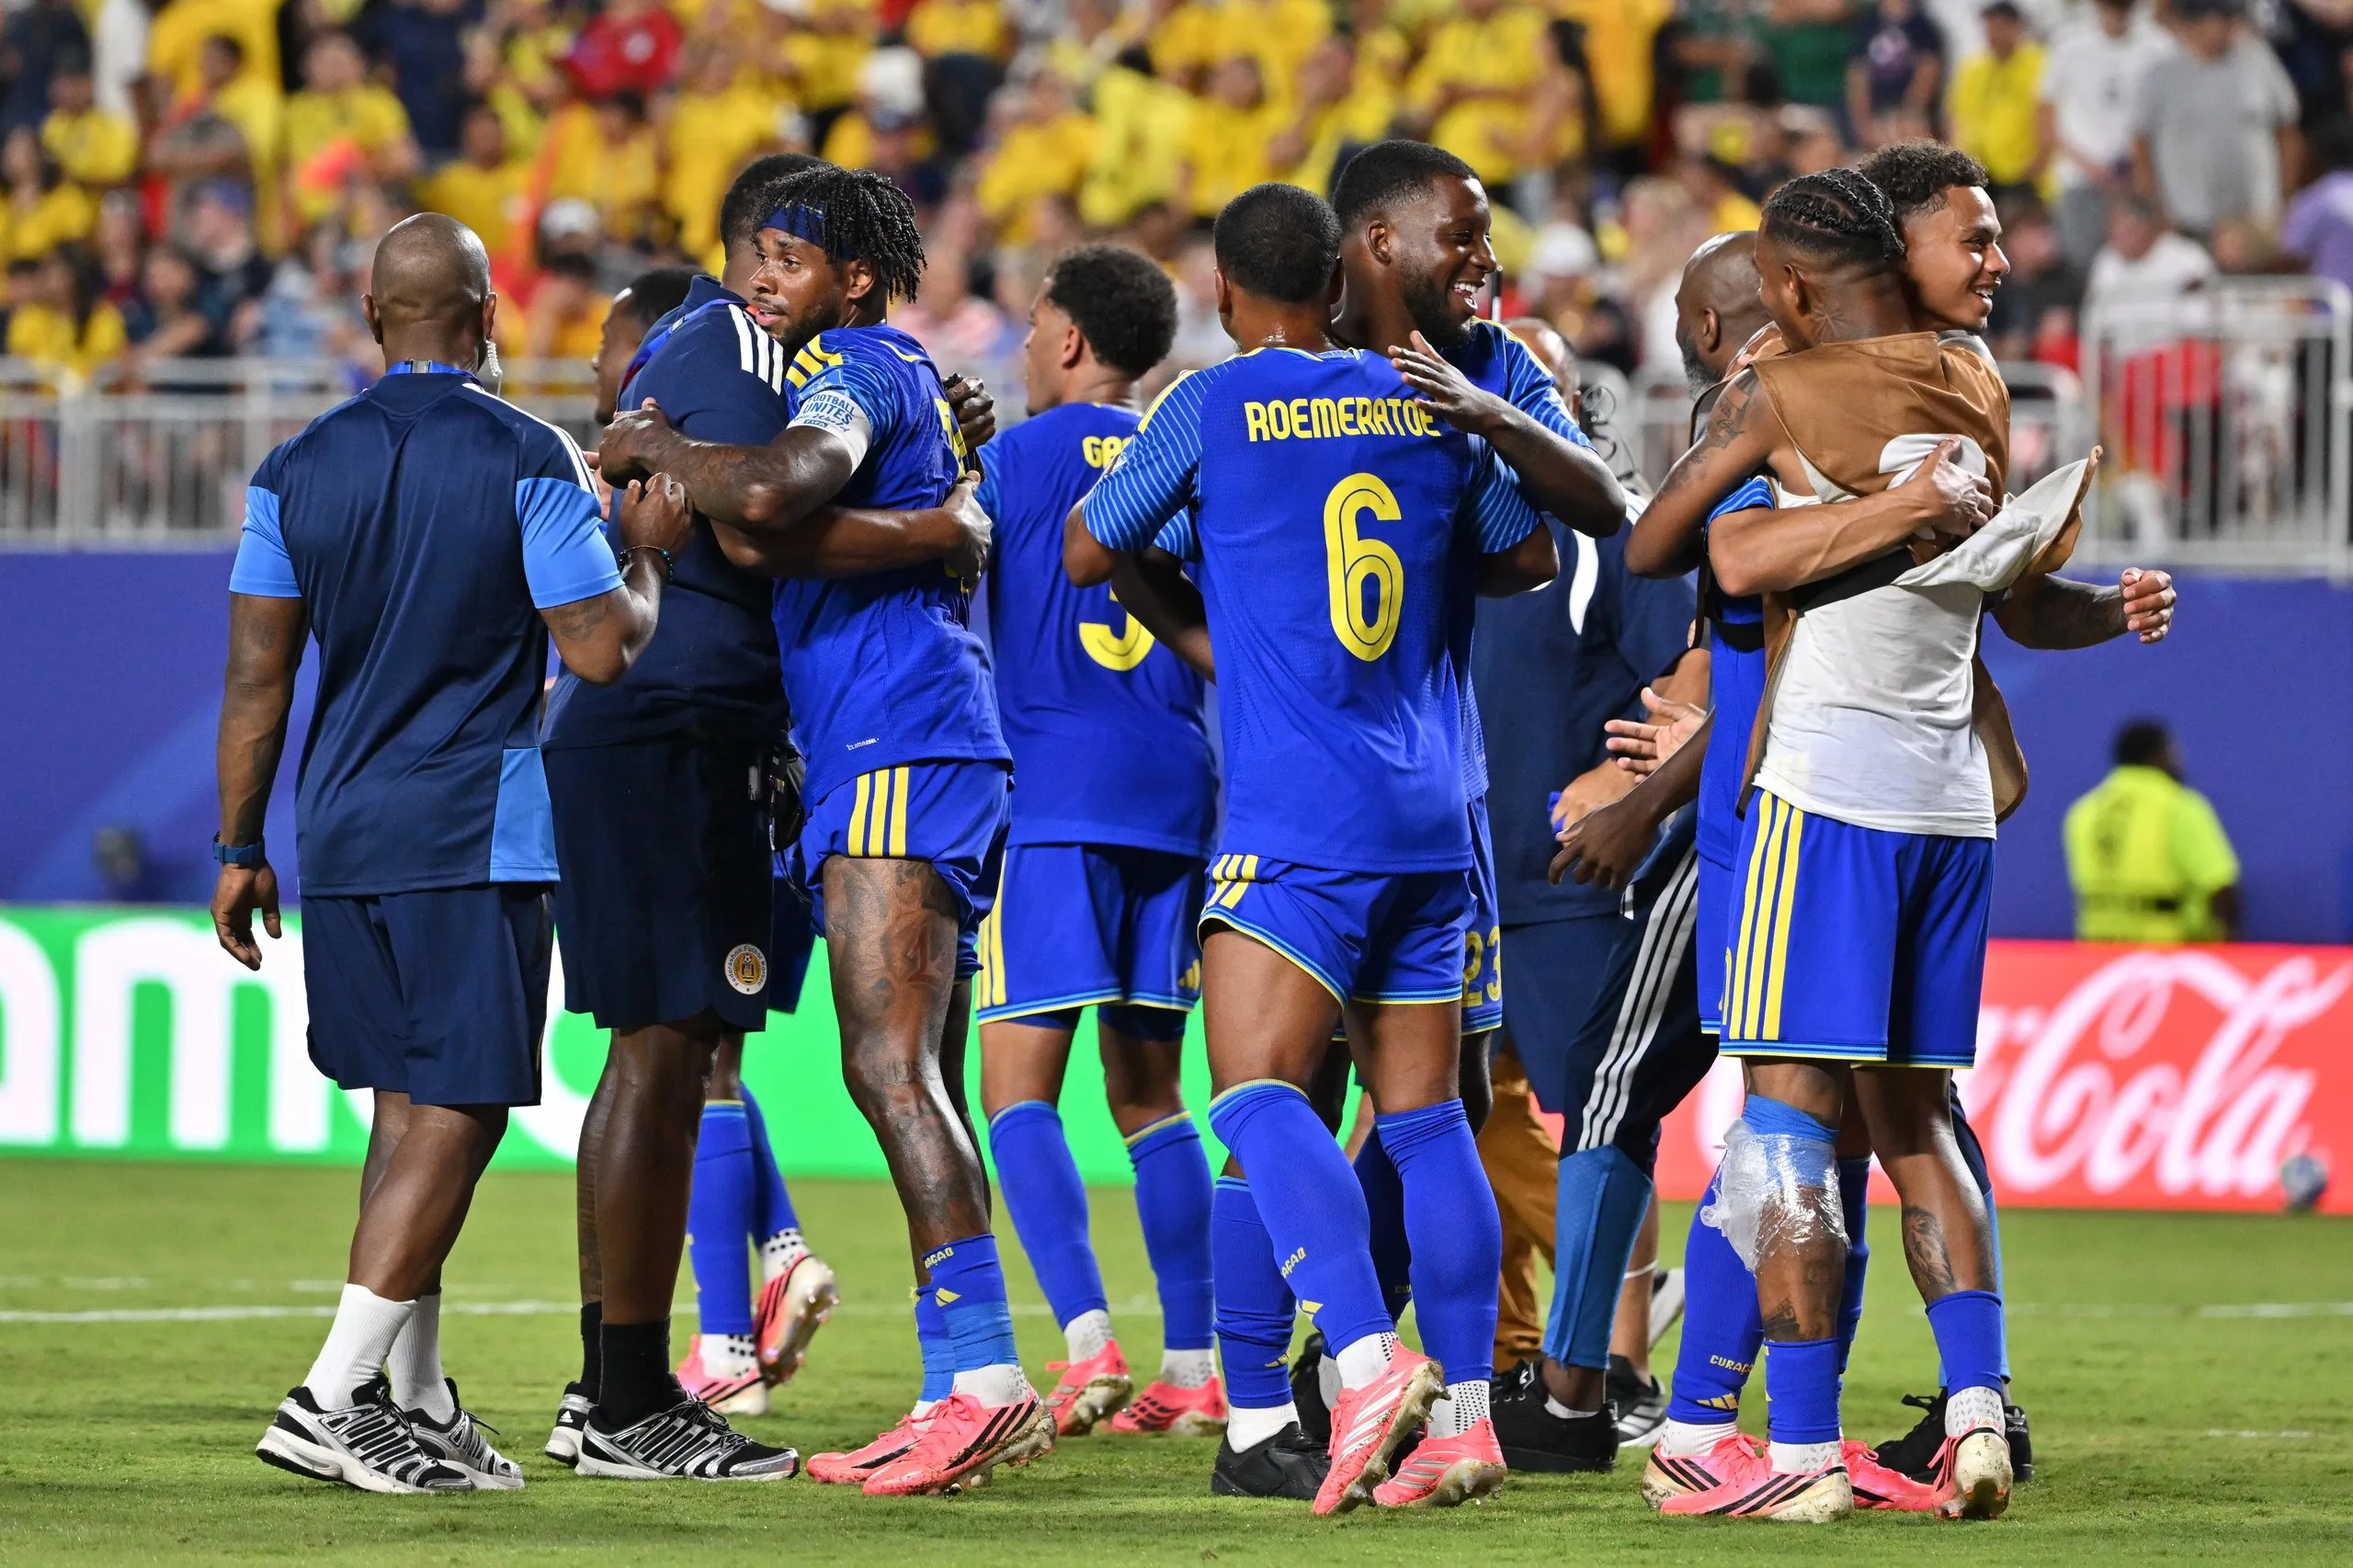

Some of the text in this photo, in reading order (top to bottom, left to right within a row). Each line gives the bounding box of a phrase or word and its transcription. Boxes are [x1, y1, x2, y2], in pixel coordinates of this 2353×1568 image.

[803, 402, 853, 425] UNITES
[808, 393, 856, 417] FOOTBALL
[1244, 397, 1441, 442] ROEMERATOE
[1082, 436, 1132, 470] GA
[1324, 472, 1404, 662] 6
[1461, 926, 1502, 1008] 23
